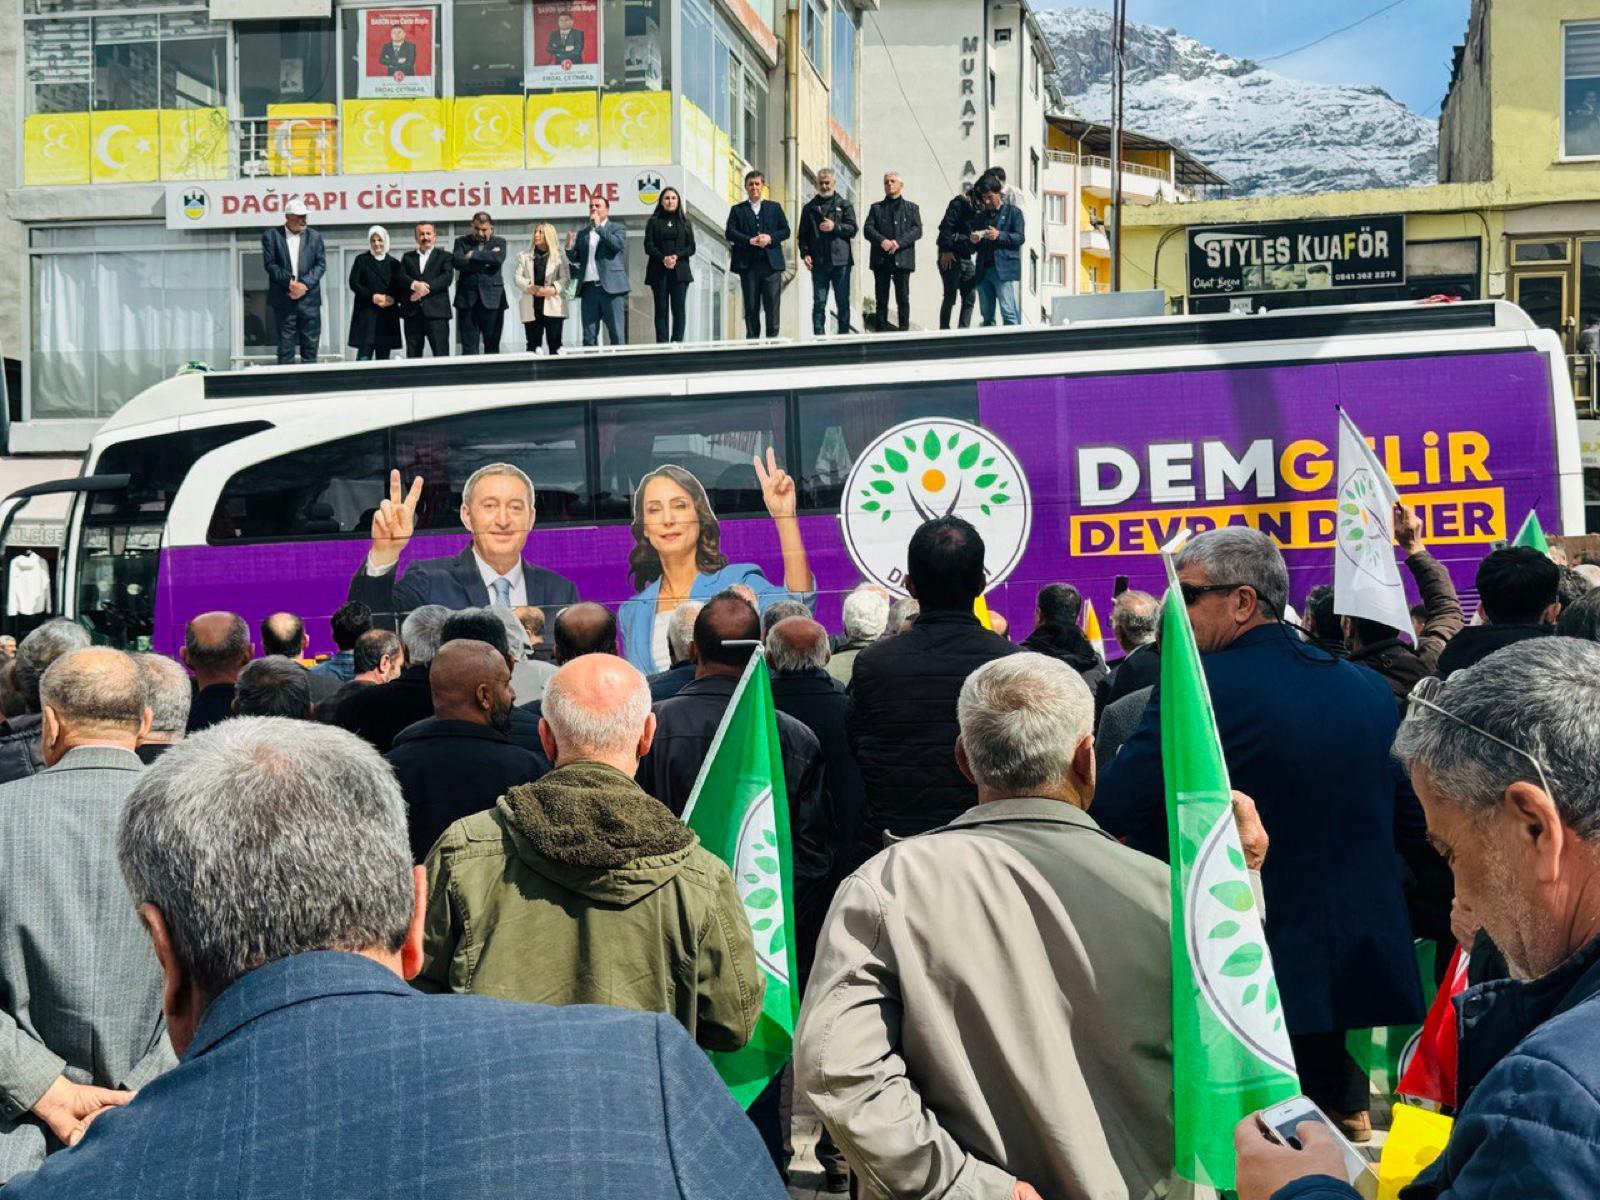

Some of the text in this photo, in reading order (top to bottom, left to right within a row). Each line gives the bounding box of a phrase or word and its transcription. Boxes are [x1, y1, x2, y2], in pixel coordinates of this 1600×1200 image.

[961, 36, 978, 137] MURAT
[357, 180, 491, 210] CİĞERCİSİ
[500, 183, 620, 206] MEHEME
[1206, 226, 1389, 269] STYLES KUAFÖR
[1308, 501, 1496, 544] DER
